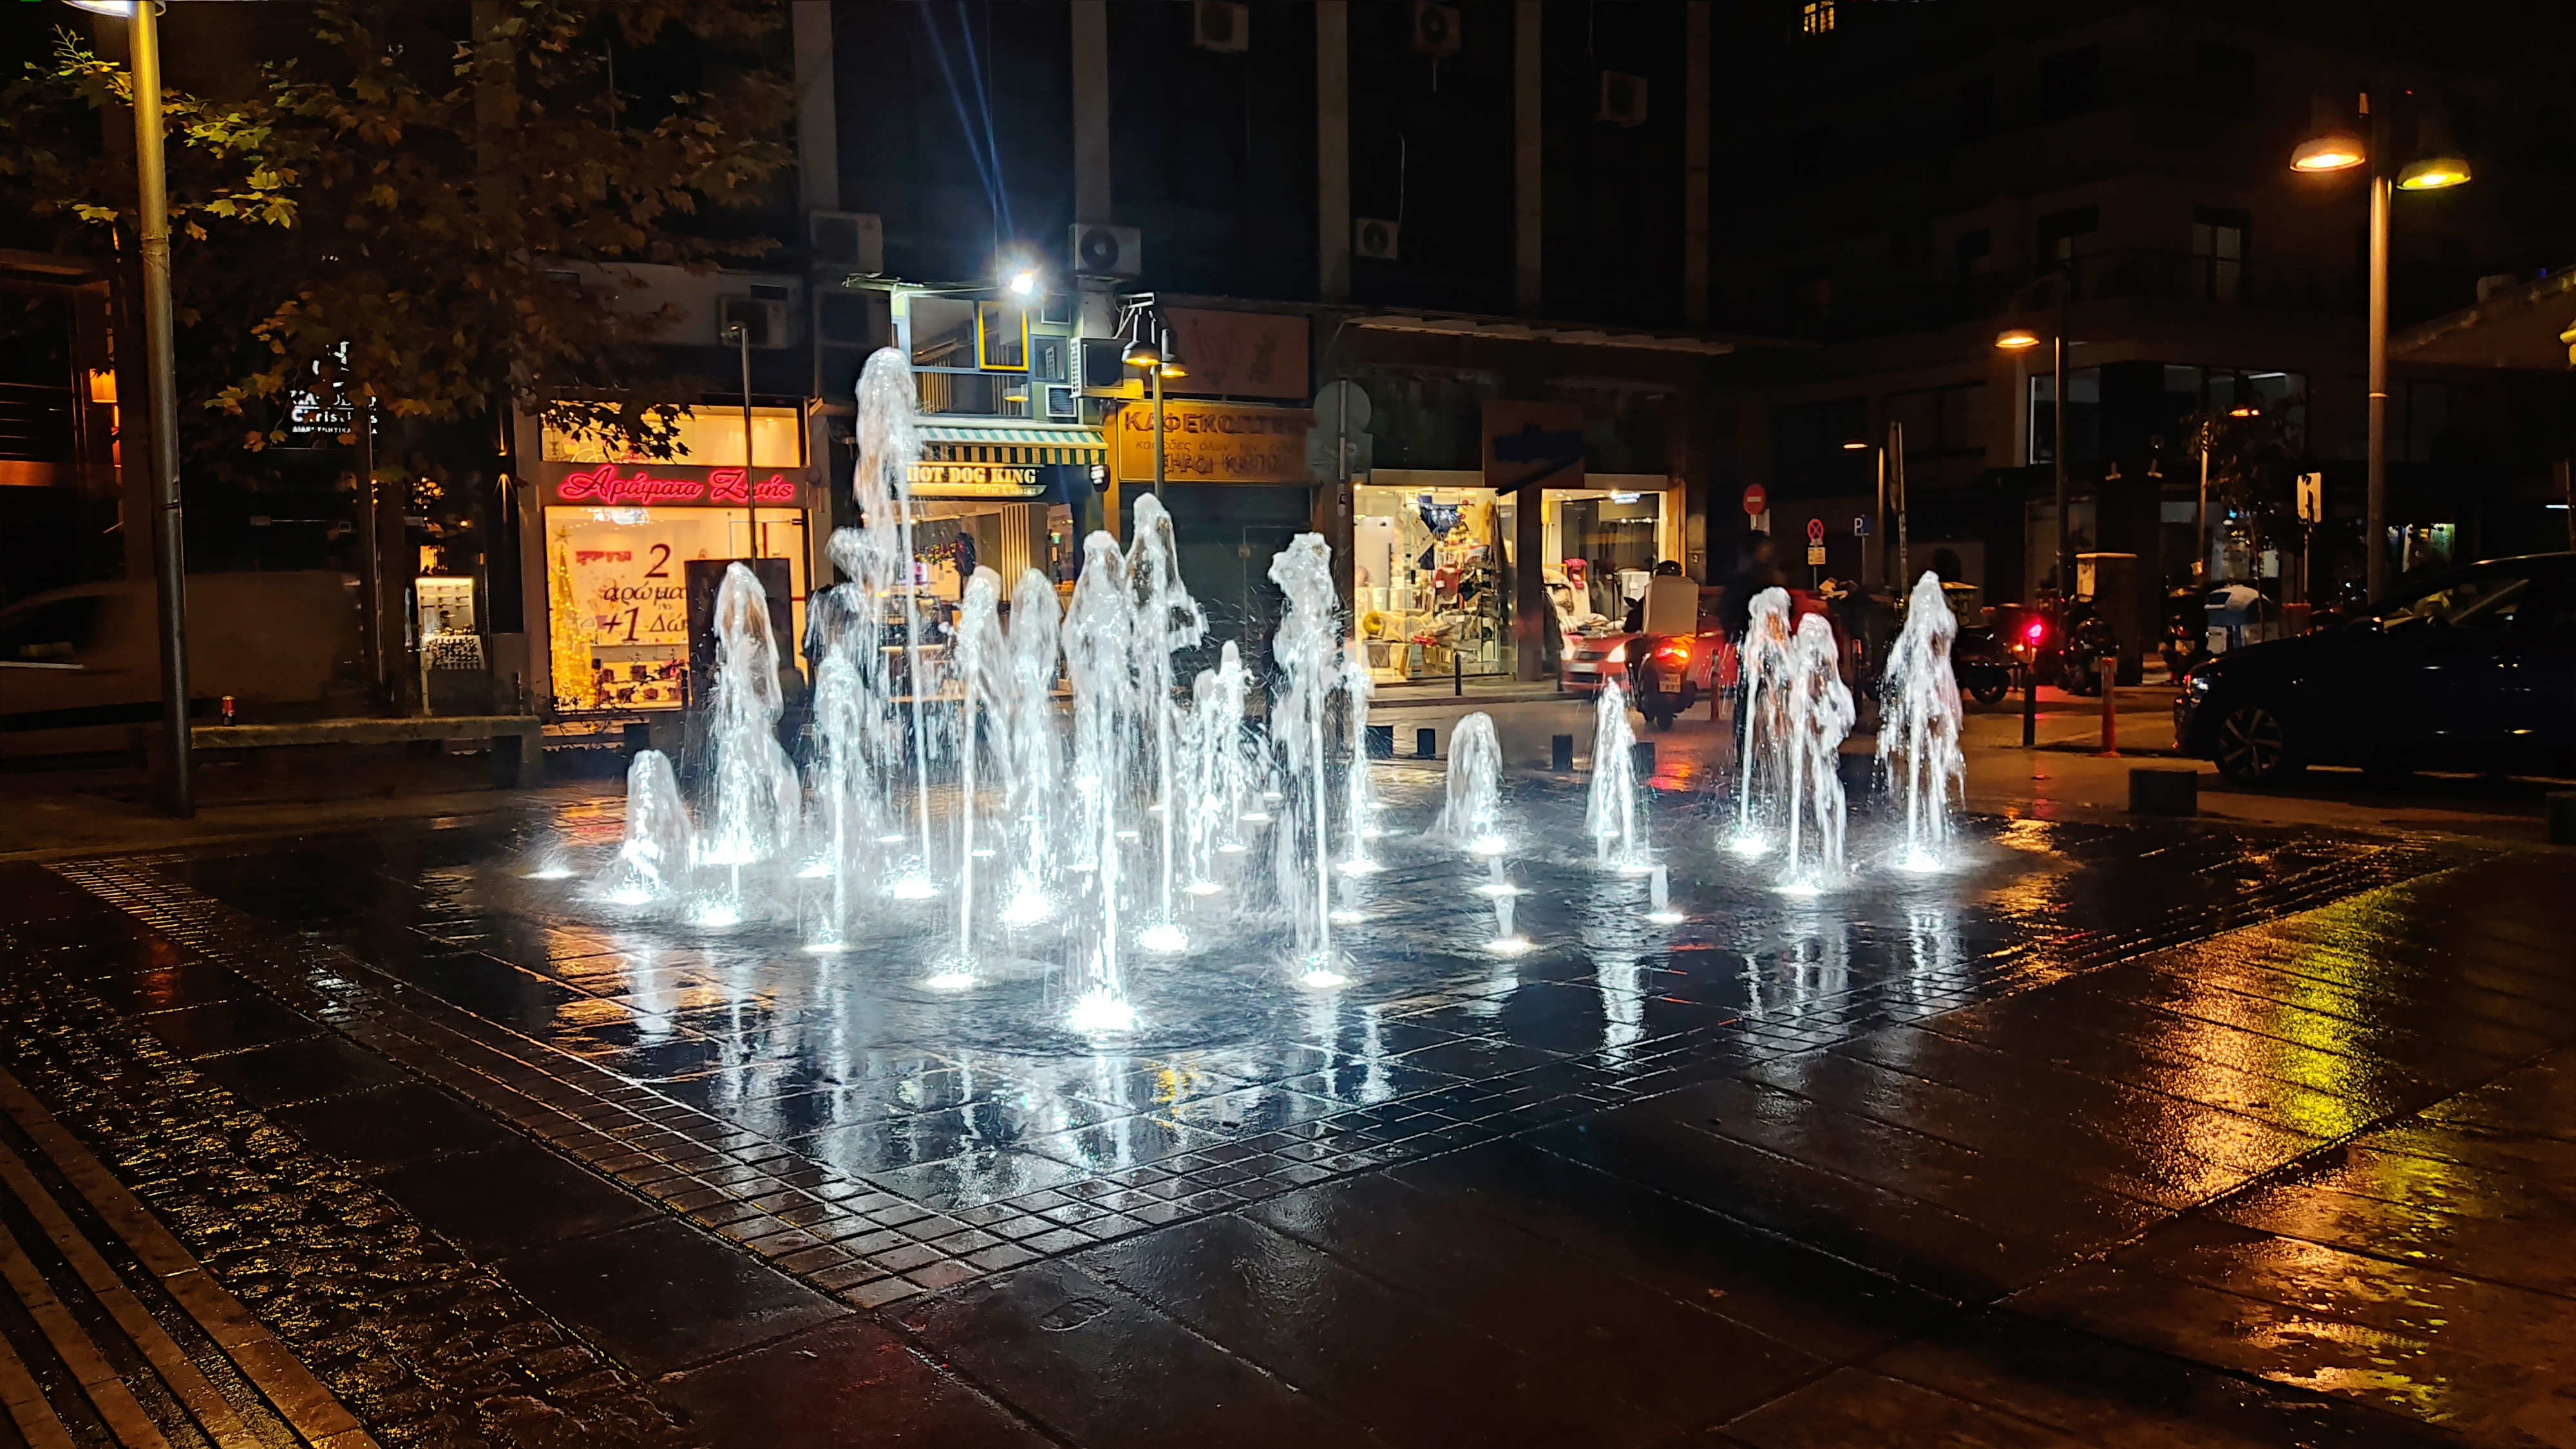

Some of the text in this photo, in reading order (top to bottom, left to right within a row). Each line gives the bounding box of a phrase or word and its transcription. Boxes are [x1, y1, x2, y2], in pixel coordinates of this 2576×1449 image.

[560, 465, 794, 503] Αρώματα Ζωής
[906, 466, 1037, 484] HOT DOG KING
[644, 544, 670, 578] 2
[602, 607, 639, 641] +1
